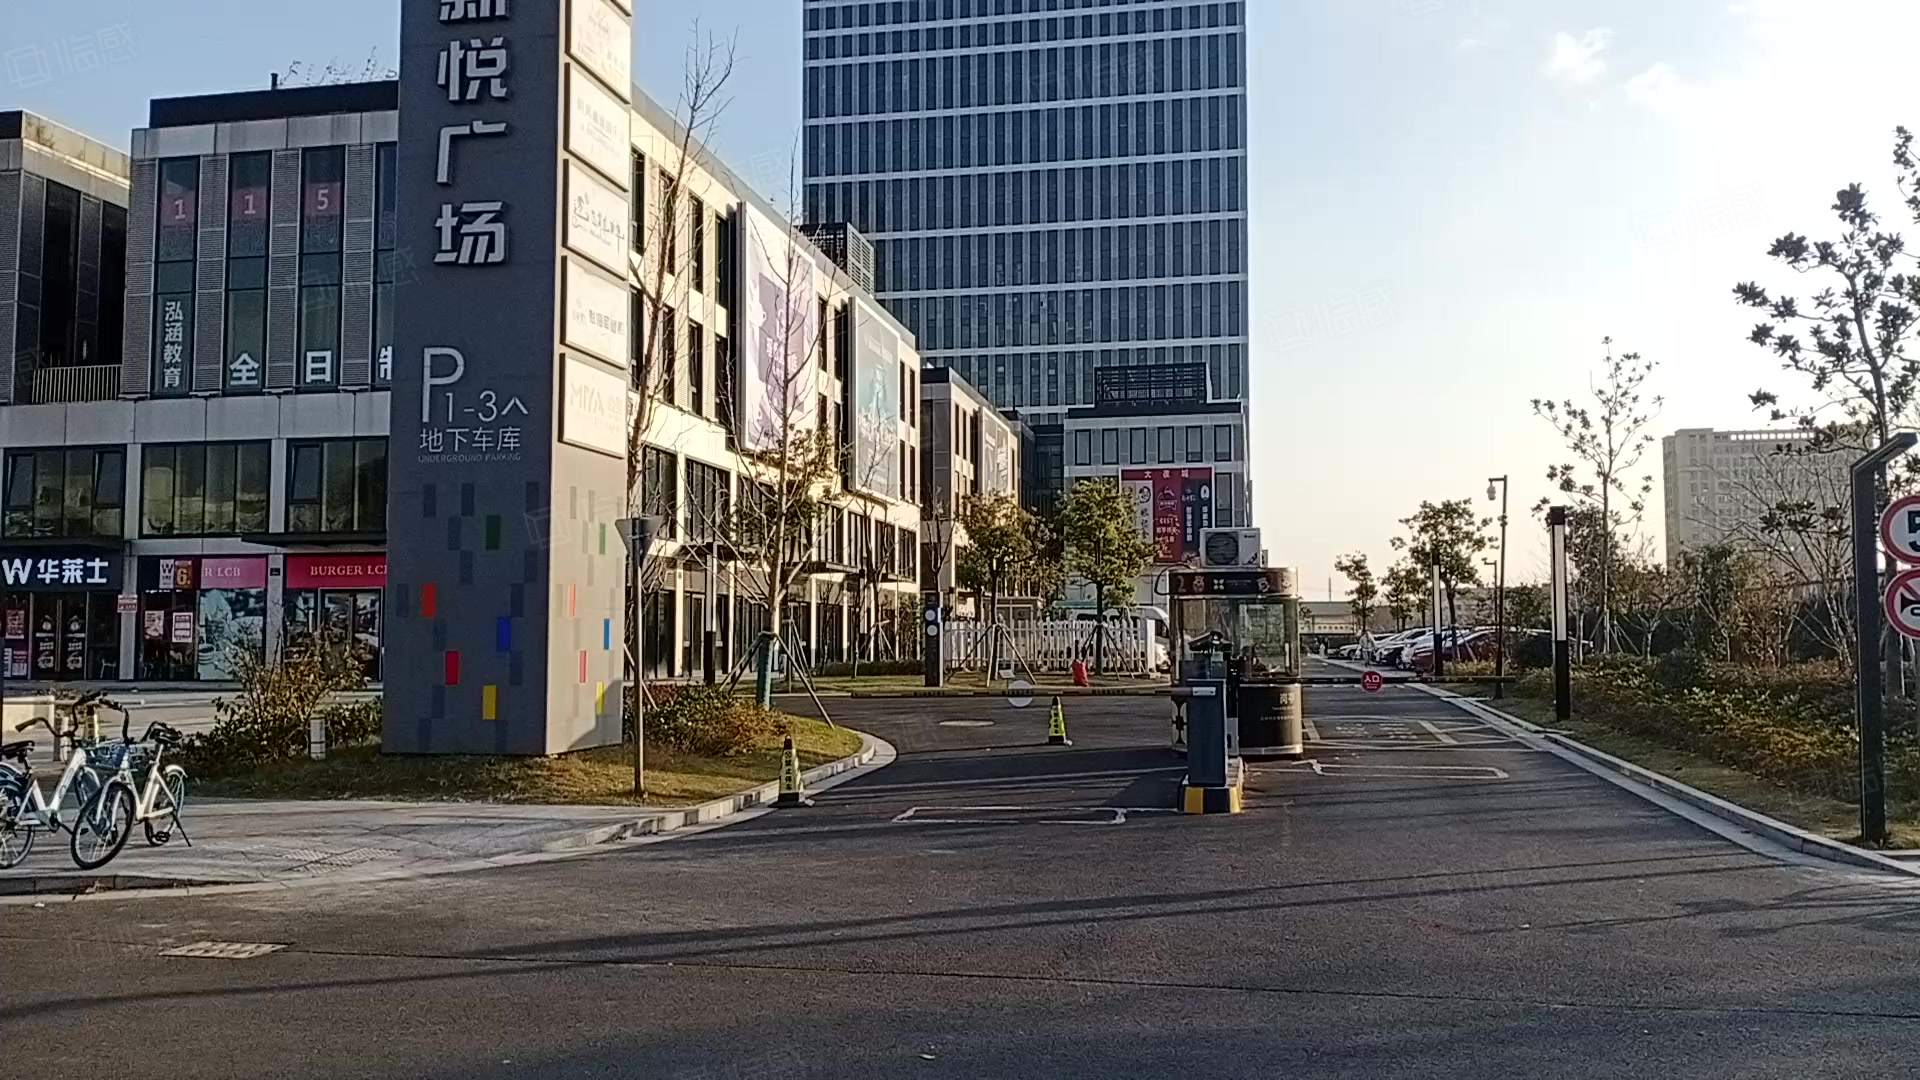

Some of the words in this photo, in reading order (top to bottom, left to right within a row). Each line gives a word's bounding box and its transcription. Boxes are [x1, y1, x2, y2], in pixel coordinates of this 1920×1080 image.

[174, 198, 186, 220] 1
[244, 194, 256, 215] 1
[317, 189, 329, 210] 5
[163, 301, 184, 388] 泓涵教育
[419, 426, 521, 452] 地下车库
[418, 454, 482, 463] UNDERGROUND
[485, 452, 521, 461] PARKING
[36, 557, 109, 584] 华莱士
[217, 567, 241, 577] LCB
[310, 565, 363, 577] BURGER
[1364, 675, 1380, 683] 入口
